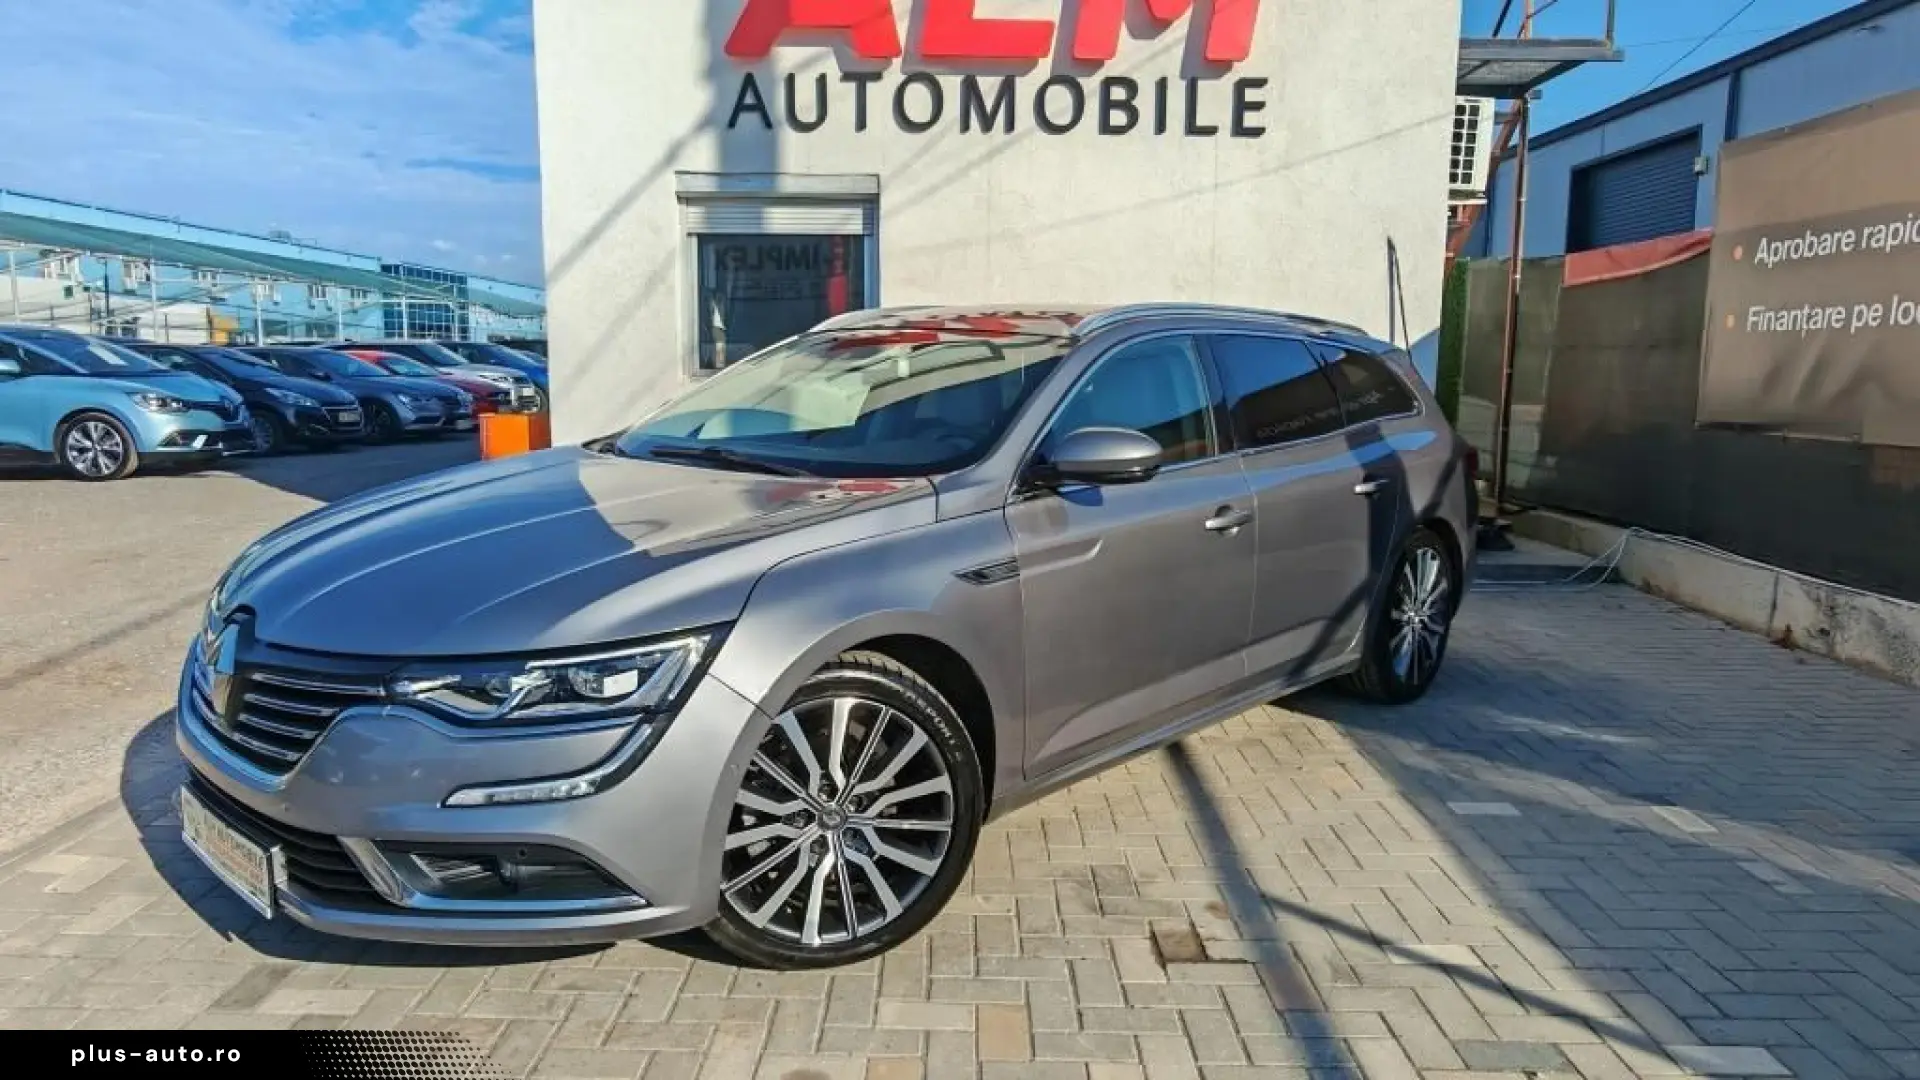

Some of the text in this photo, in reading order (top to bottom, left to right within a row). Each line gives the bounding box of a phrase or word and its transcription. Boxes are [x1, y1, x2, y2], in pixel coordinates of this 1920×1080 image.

[728, 71, 1268, 137] AUTOMOBILE
[1754, 229, 1856, 268] Aprobare
[1747, 304, 1846, 340] Finanțare
[1850, 302, 1884, 334] pe
